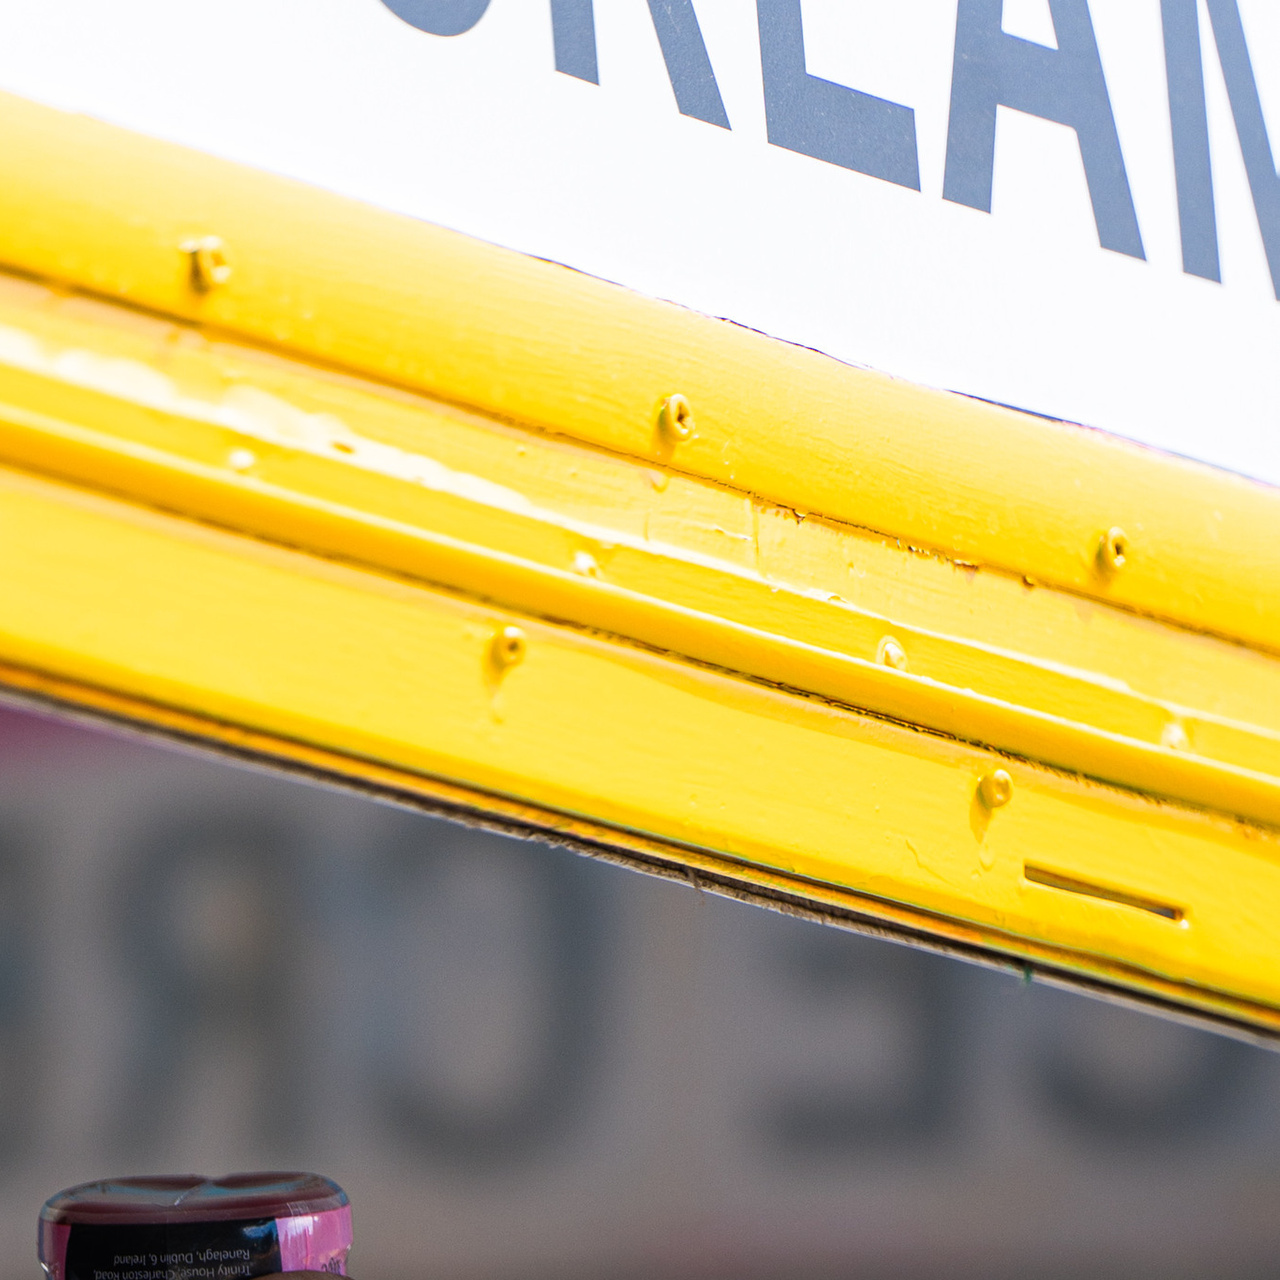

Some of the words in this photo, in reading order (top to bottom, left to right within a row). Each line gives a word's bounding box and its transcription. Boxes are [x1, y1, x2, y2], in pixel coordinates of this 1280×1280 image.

[114, 1253, 146, 1266] Ireland
[160, 1252, 193, 1264] Dublin
[196, 1249, 250, 1264] Ranelagh,
[122, 1269, 176, 1280] Charleston
[217, 1265, 250, 1277] Trinity
